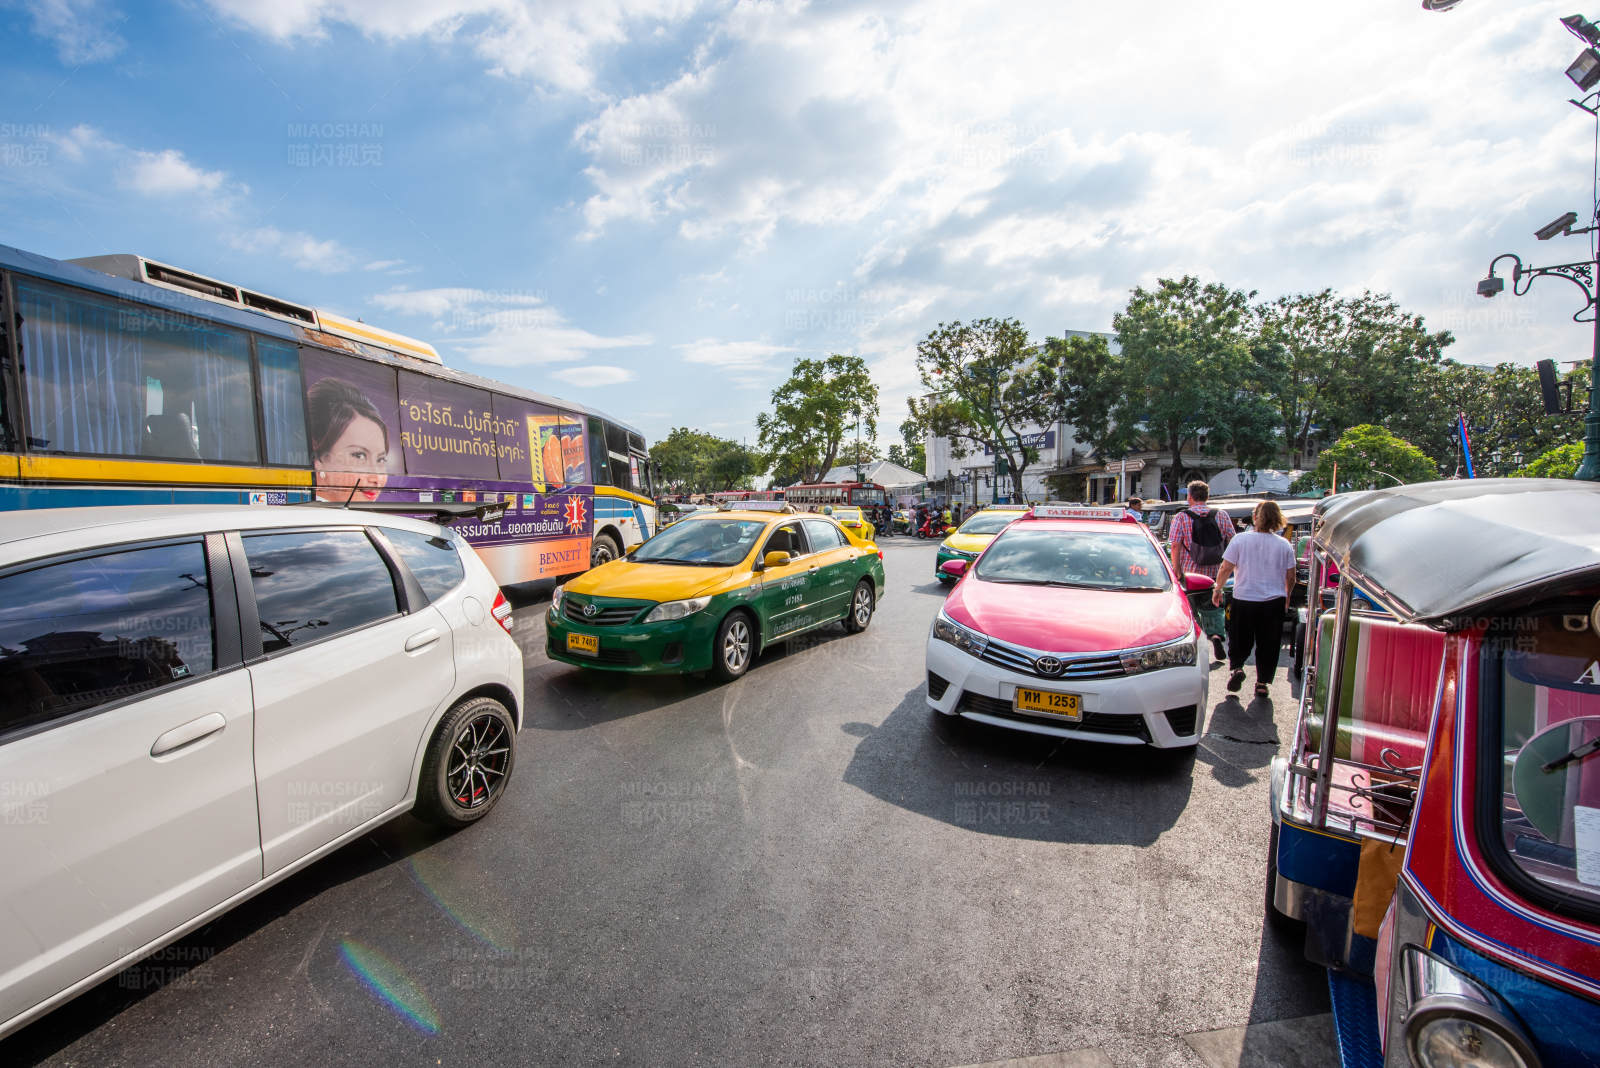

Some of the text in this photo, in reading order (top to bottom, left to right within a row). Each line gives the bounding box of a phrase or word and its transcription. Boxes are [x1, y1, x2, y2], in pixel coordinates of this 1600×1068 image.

[571, 501, 579, 524] 1
[540, 549, 581, 566] BENNETT
[1048, 695, 1076, 709] 1253
